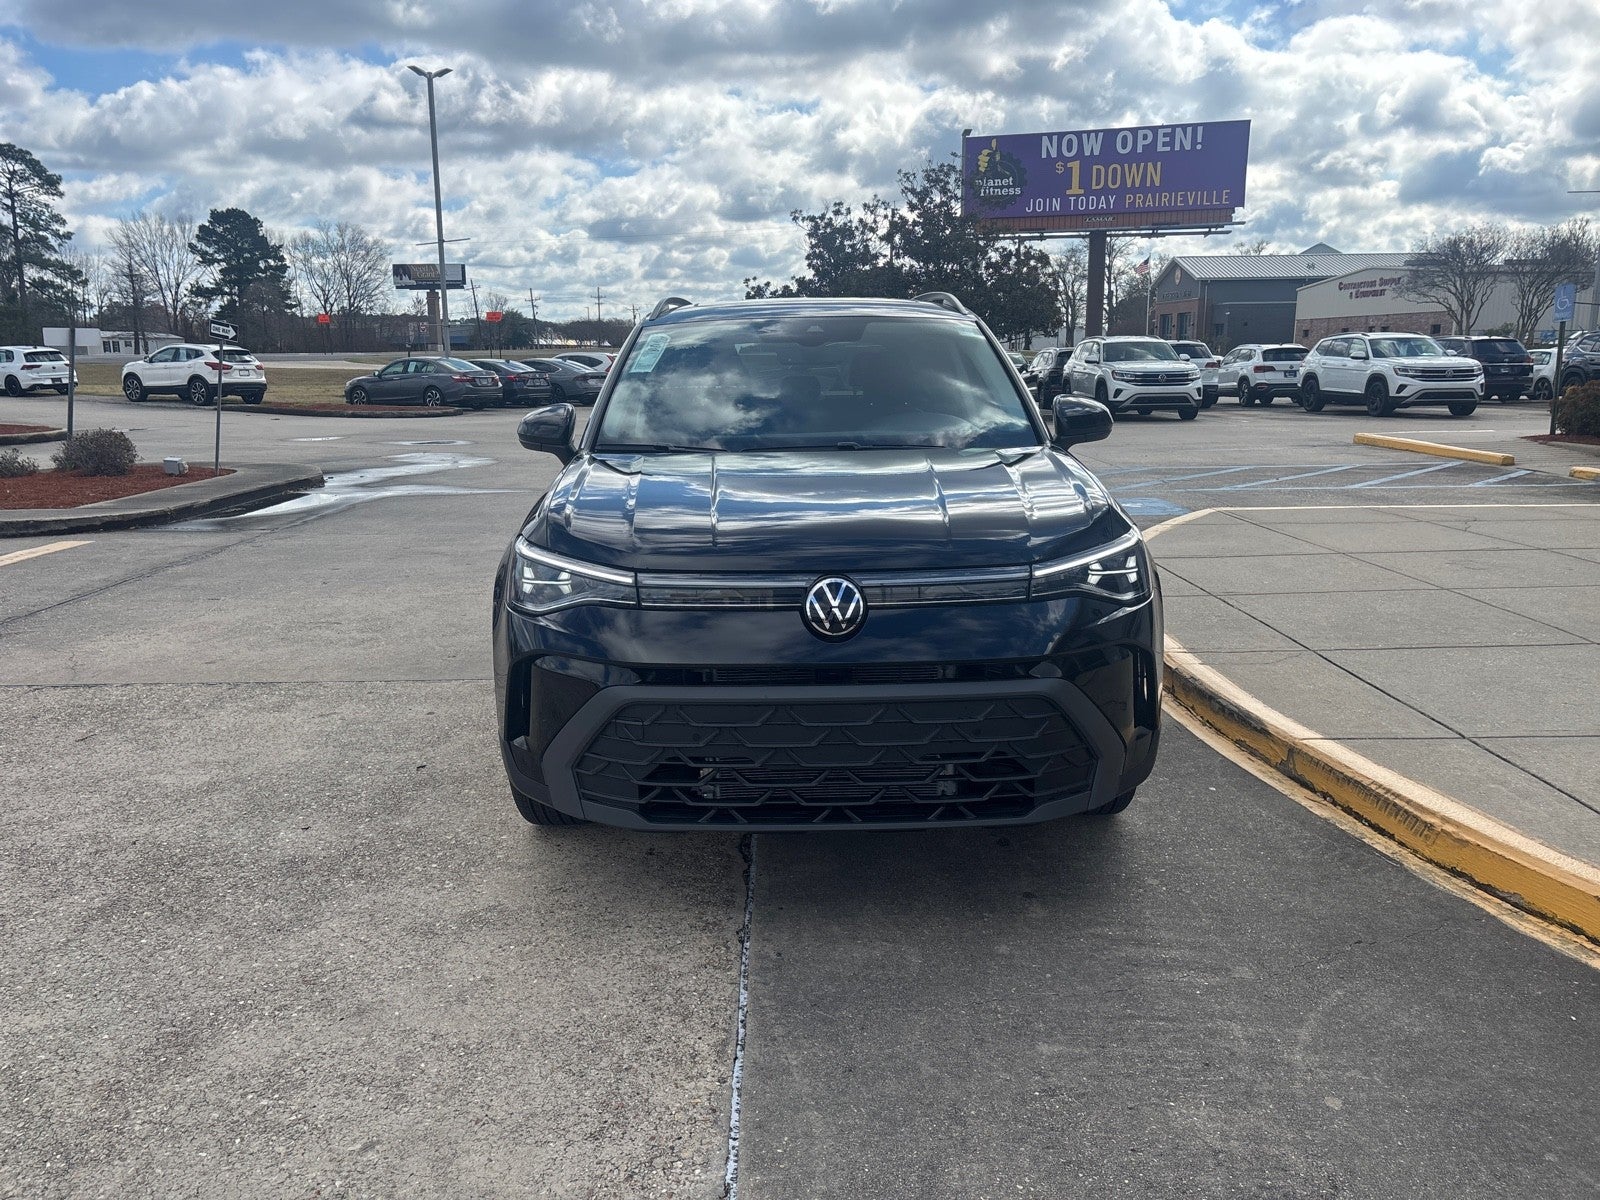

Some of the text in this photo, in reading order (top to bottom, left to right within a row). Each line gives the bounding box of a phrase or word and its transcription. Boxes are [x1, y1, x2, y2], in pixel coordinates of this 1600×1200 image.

[1041, 126, 1204, 159] NOW OPEN!
[1091, 162, 1162, 190] DOWN
[980, 186, 1022, 197] fitness
[1025, 190, 1231, 213] JOIN TODAY PRAIRIEVILLE
[212, 325, 231, 335] ONE WAY
